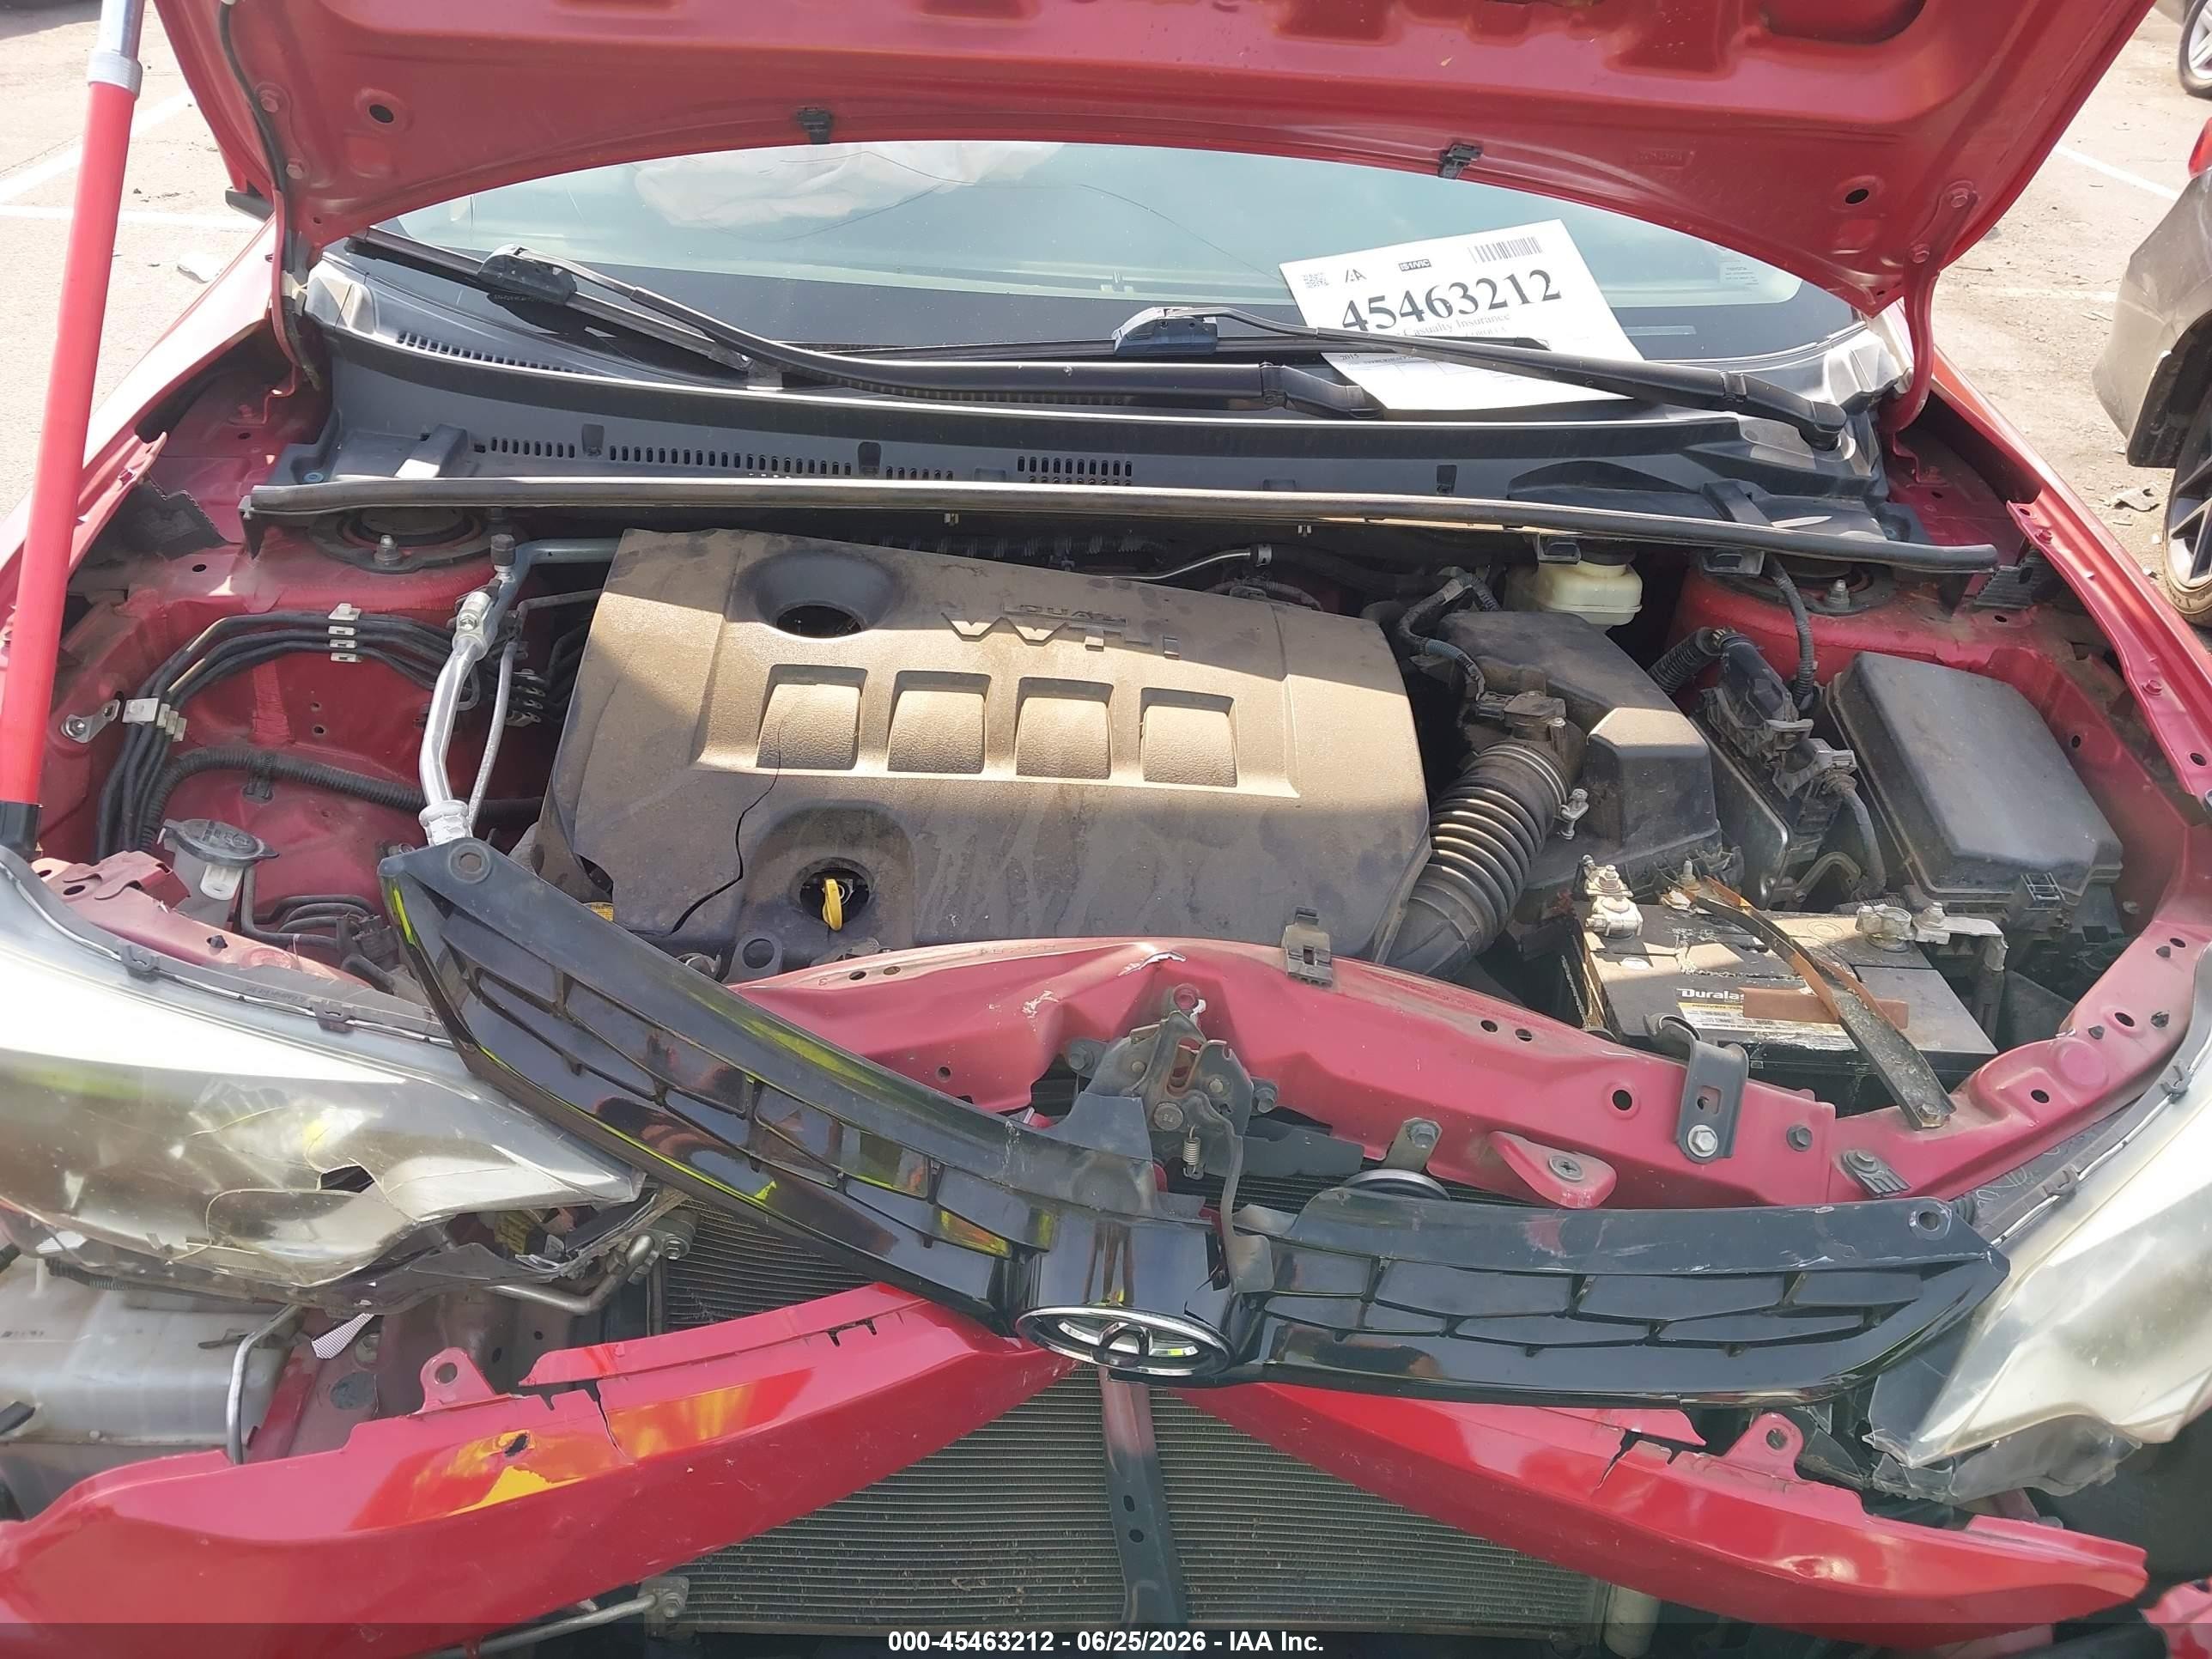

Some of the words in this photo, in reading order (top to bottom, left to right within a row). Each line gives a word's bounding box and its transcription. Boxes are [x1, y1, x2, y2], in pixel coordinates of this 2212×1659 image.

[1342, 269, 1562, 332] 45463212
[1403, 321, 1453, 337] Casualty
[1456, 313, 1510, 330] Insurance
